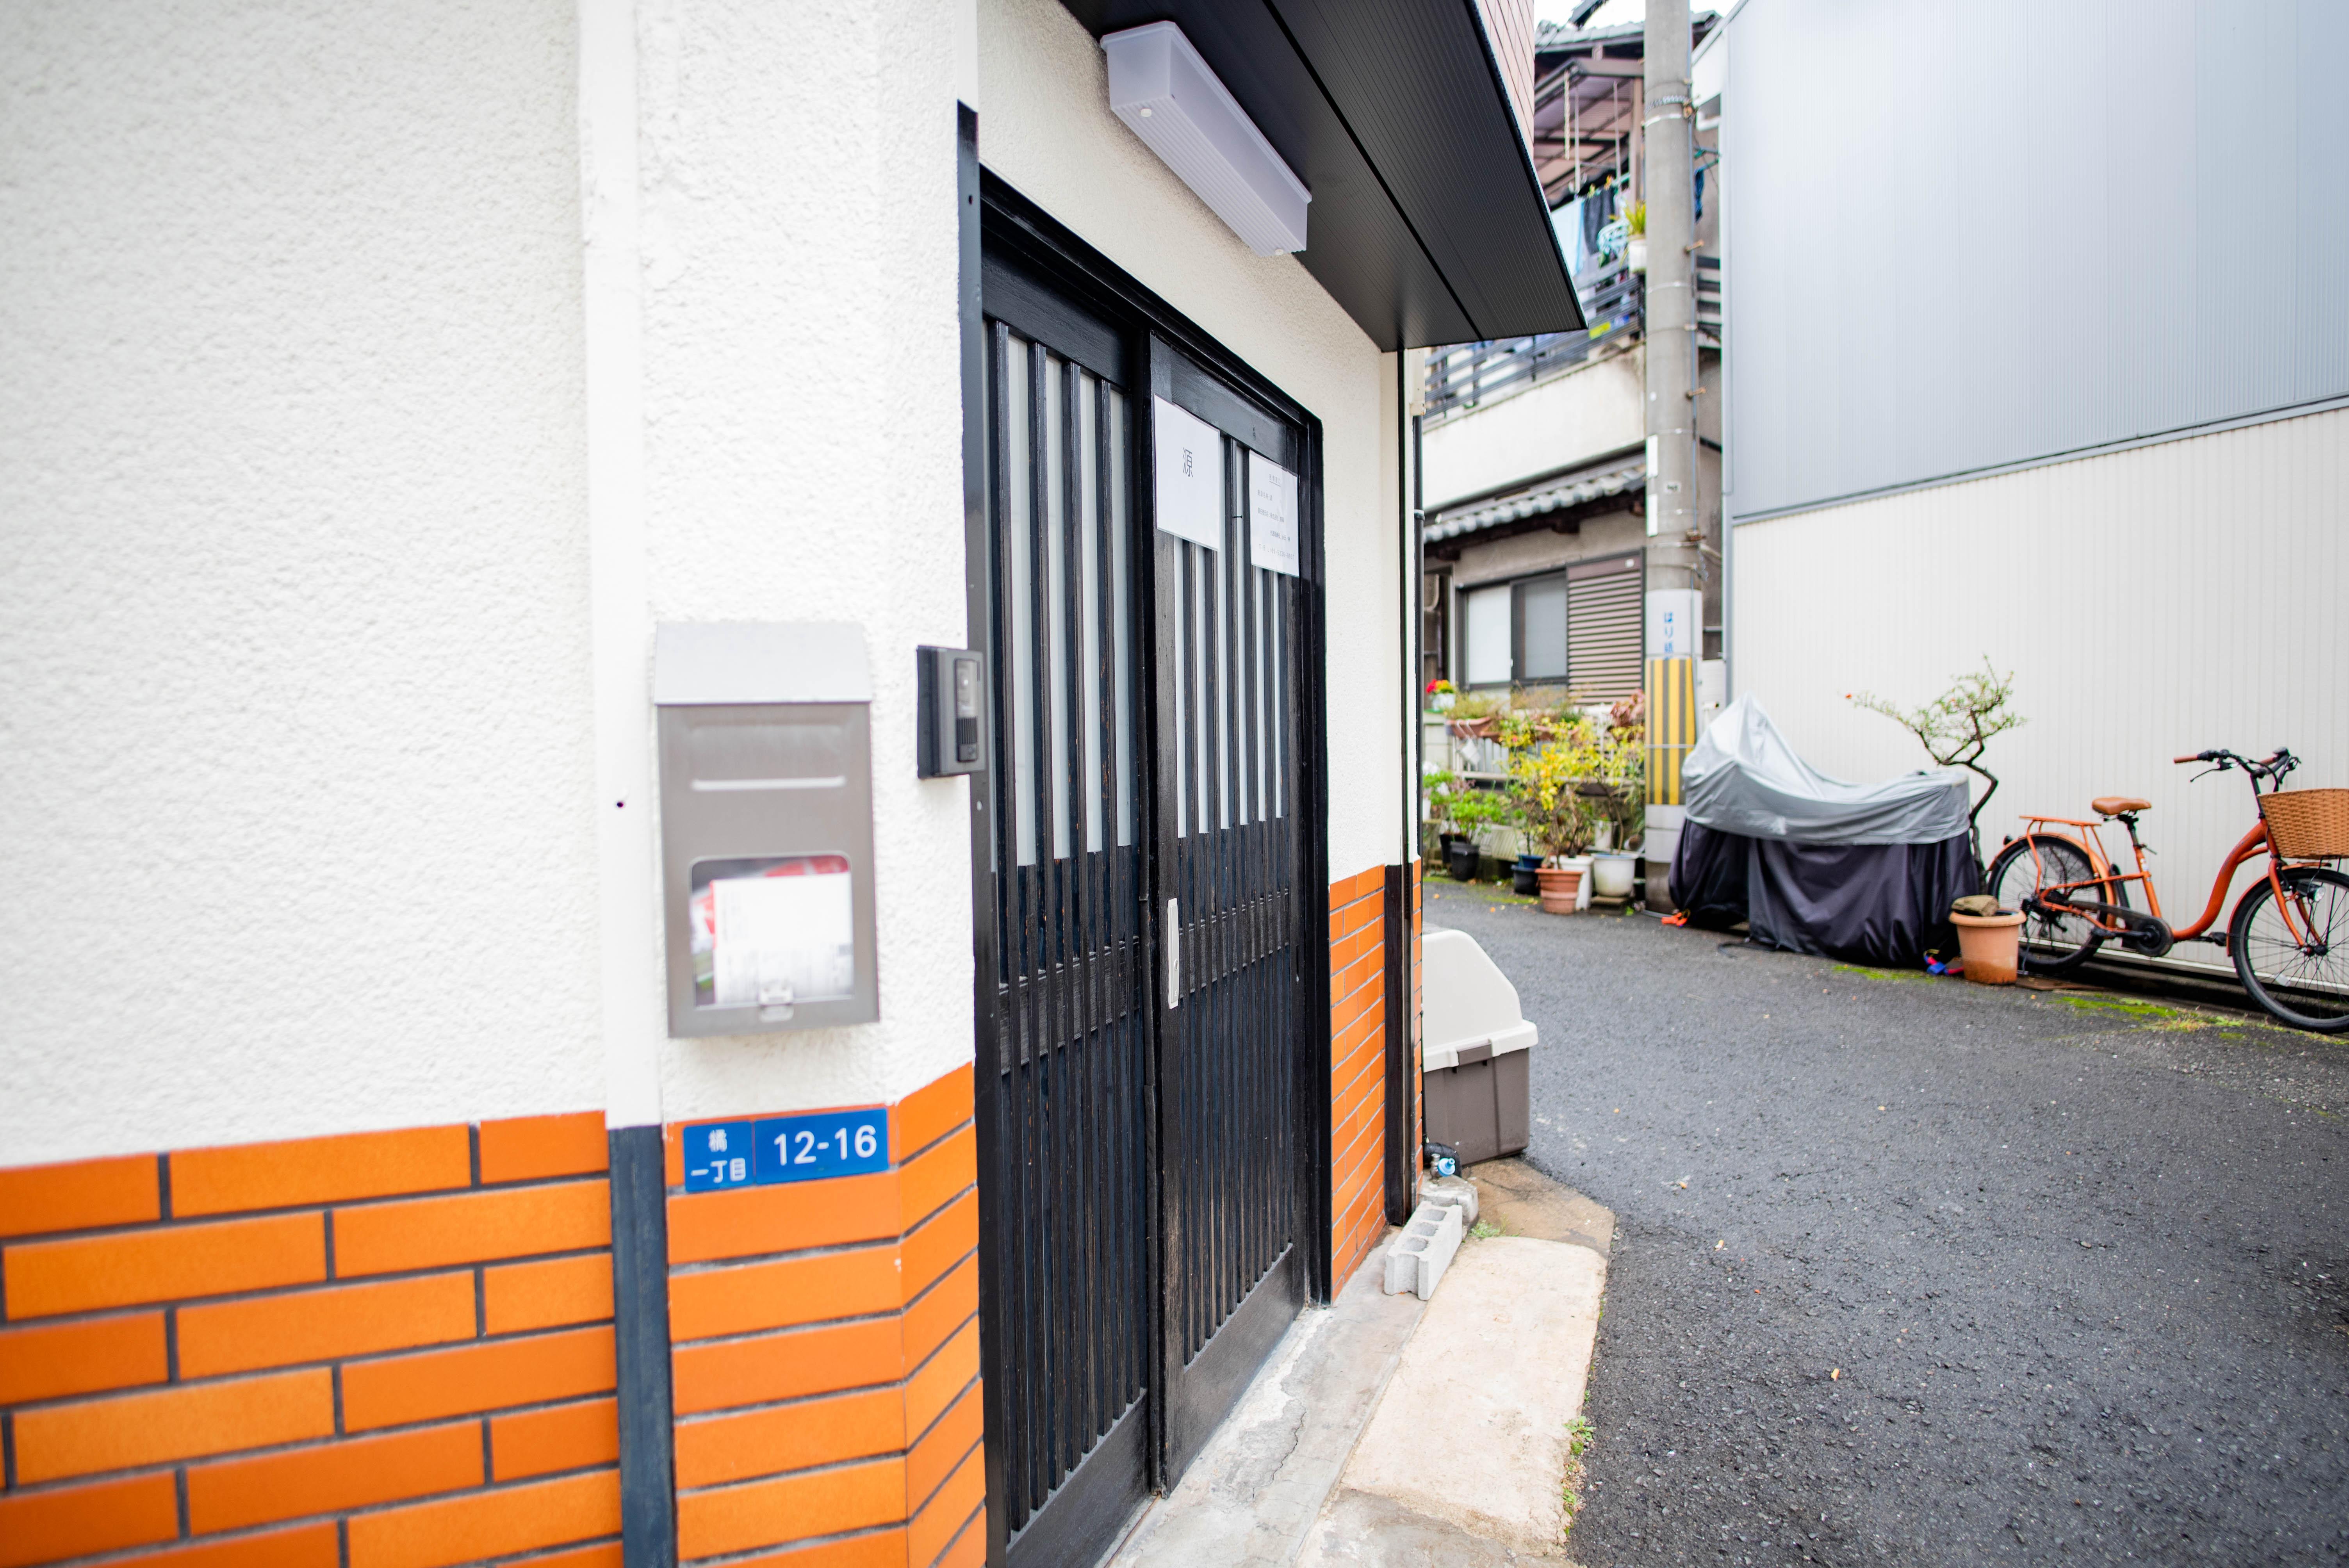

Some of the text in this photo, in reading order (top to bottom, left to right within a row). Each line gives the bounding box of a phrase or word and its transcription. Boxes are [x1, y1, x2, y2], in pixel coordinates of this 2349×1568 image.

[1183, 447, 1193, 478] 源
[774, 1124, 877, 1166] 12-16
[691, 1158, 746, 1183] 一丁目
